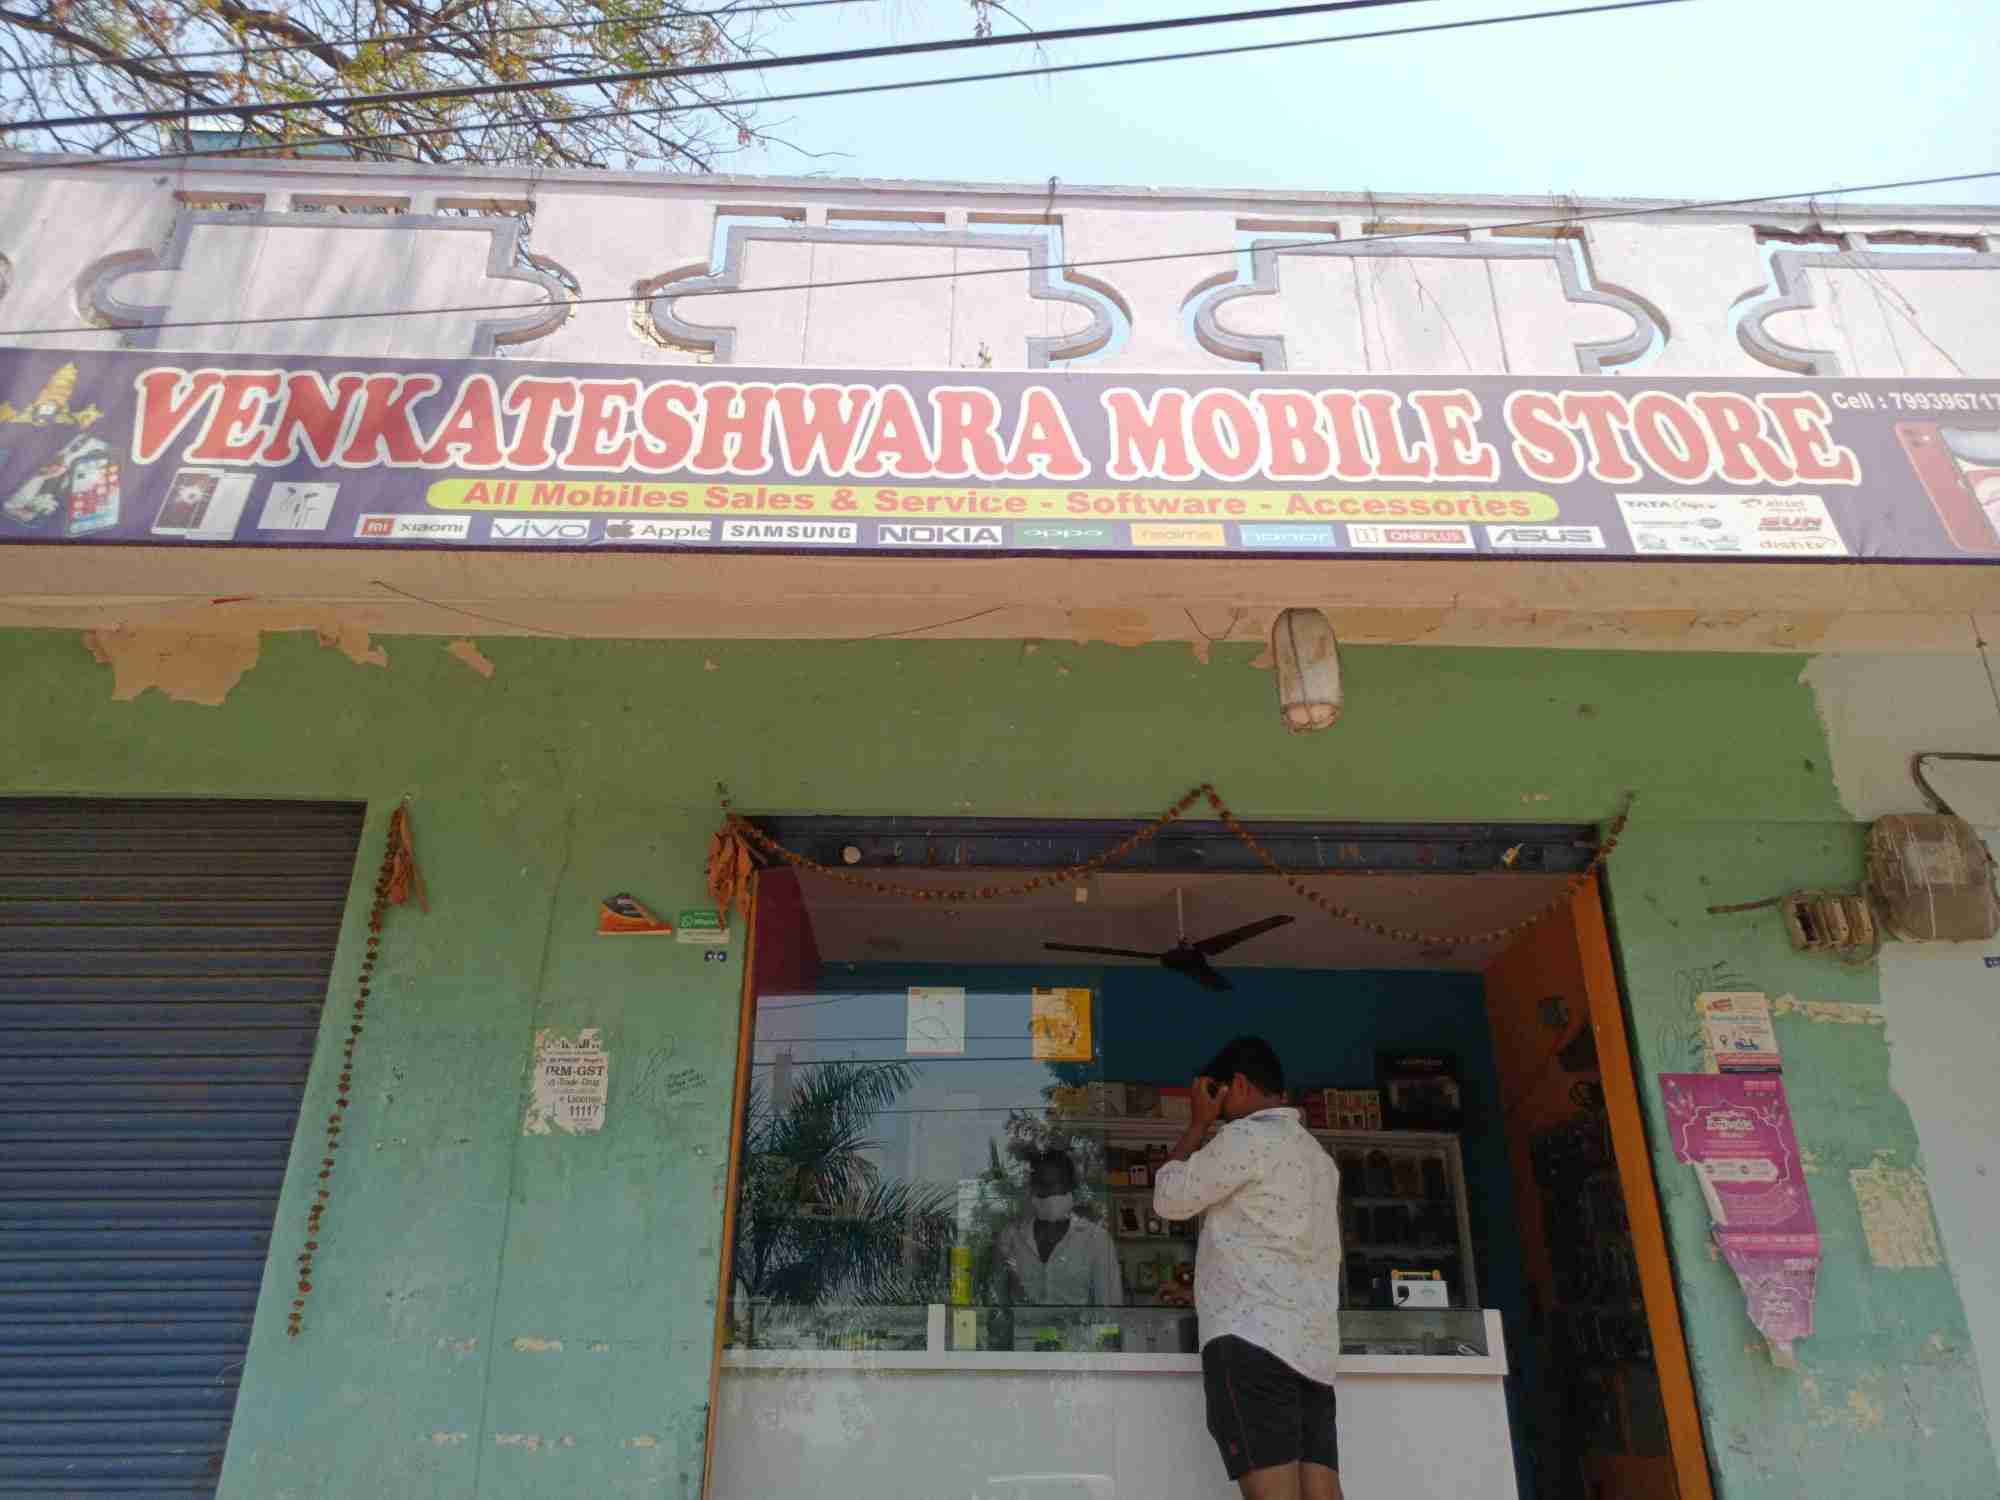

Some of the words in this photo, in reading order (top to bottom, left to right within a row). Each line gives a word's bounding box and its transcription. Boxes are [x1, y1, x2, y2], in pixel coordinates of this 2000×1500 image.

[1831, 391, 1875, 409] Cell
[131, 367, 1091, 480] VENKATESHWARA
[1101, 387, 1500, 482] MOBILE
[1504, 388, 1862, 488] STORE
[461, 479, 518, 506] All
[531, 482, 689, 509] Mobiles
[703, 485, 815, 512] Sales
[829, 486, 857, 513] &
[874, 487, 1028, 514] Service
[1065, 490, 1248, 515] Software
[1285, 493, 1531, 518] Accessories
[493, 519, 589, 538] vivo
[640, 524, 713, 540] Apple
[729, 524, 852, 539] SAMSUNG
[879, 526, 1000, 543] NOKIA
[1495, 529, 1593, 542] ASUS
